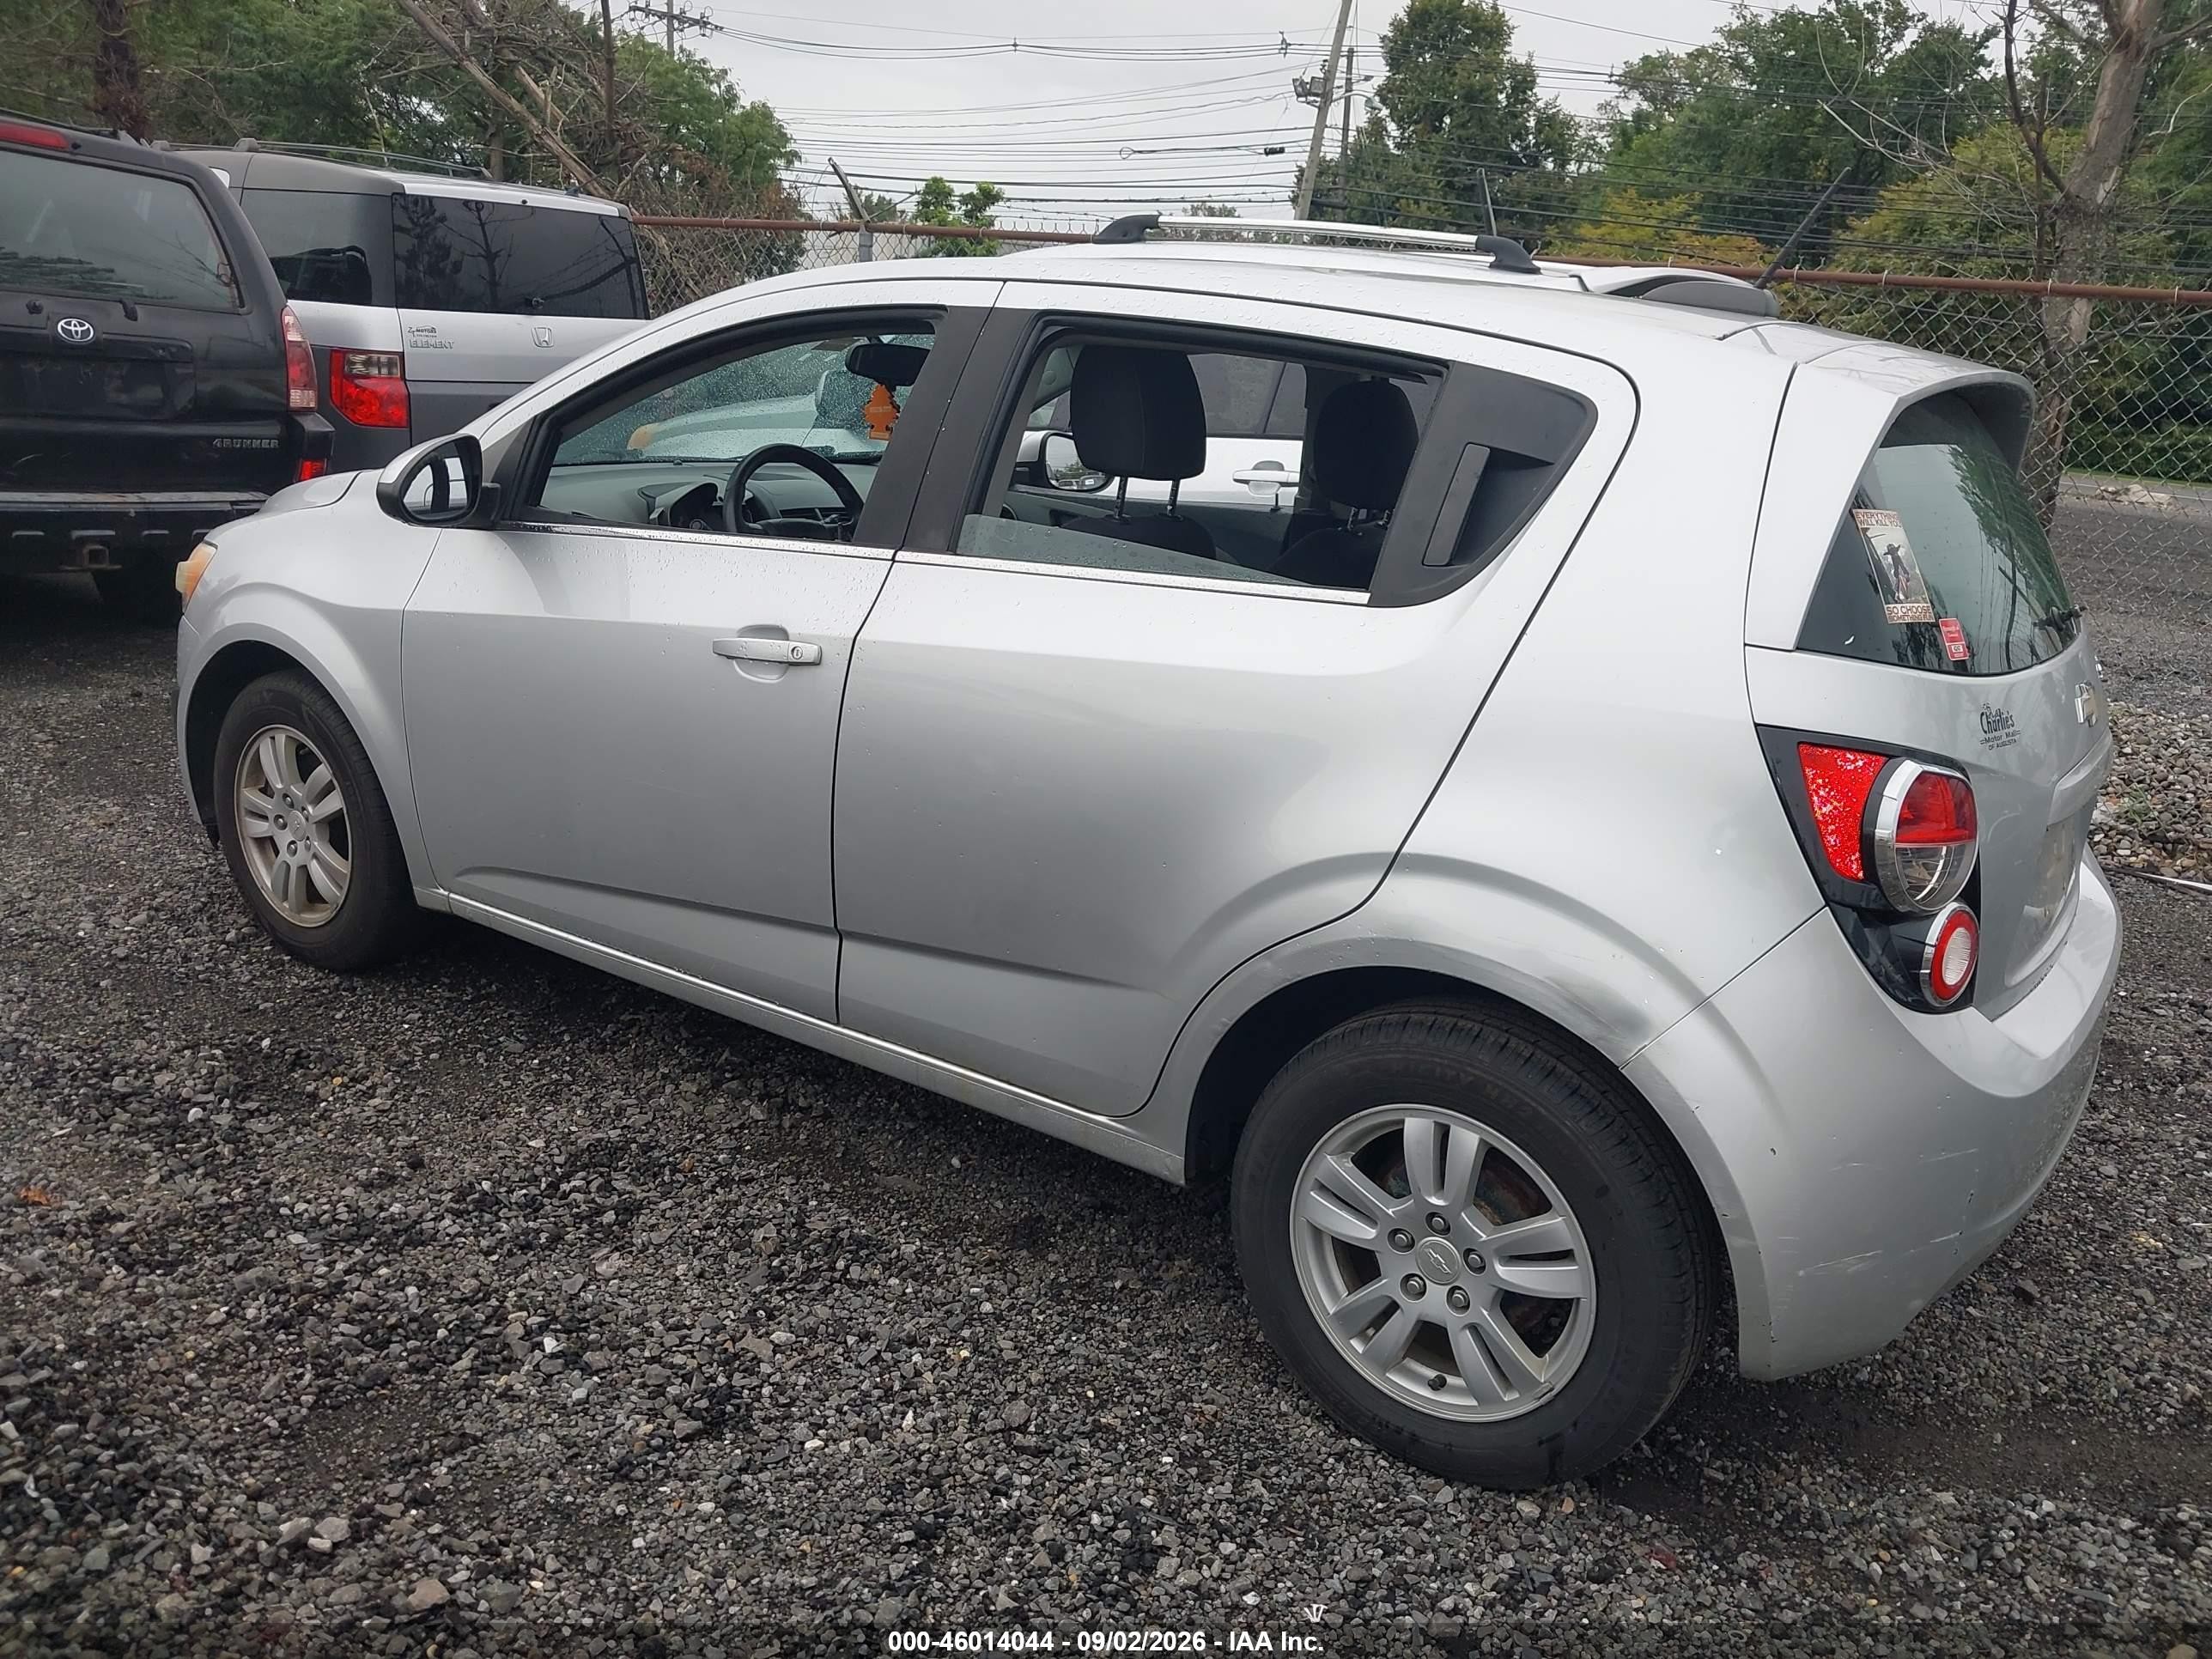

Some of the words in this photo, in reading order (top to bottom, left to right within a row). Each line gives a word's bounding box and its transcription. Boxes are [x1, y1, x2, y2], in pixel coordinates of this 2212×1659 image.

[409, 338, 454, 349] ELEMENT
[212, 438, 280, 448] 4RUNNER
[1886, 605, 1899, 616] SO
[1900, 605, 1932, 615] CHOOSE
[1980, 708, 2015, 734] Charlie's
[1984, 735, 2002, 744] Motor
